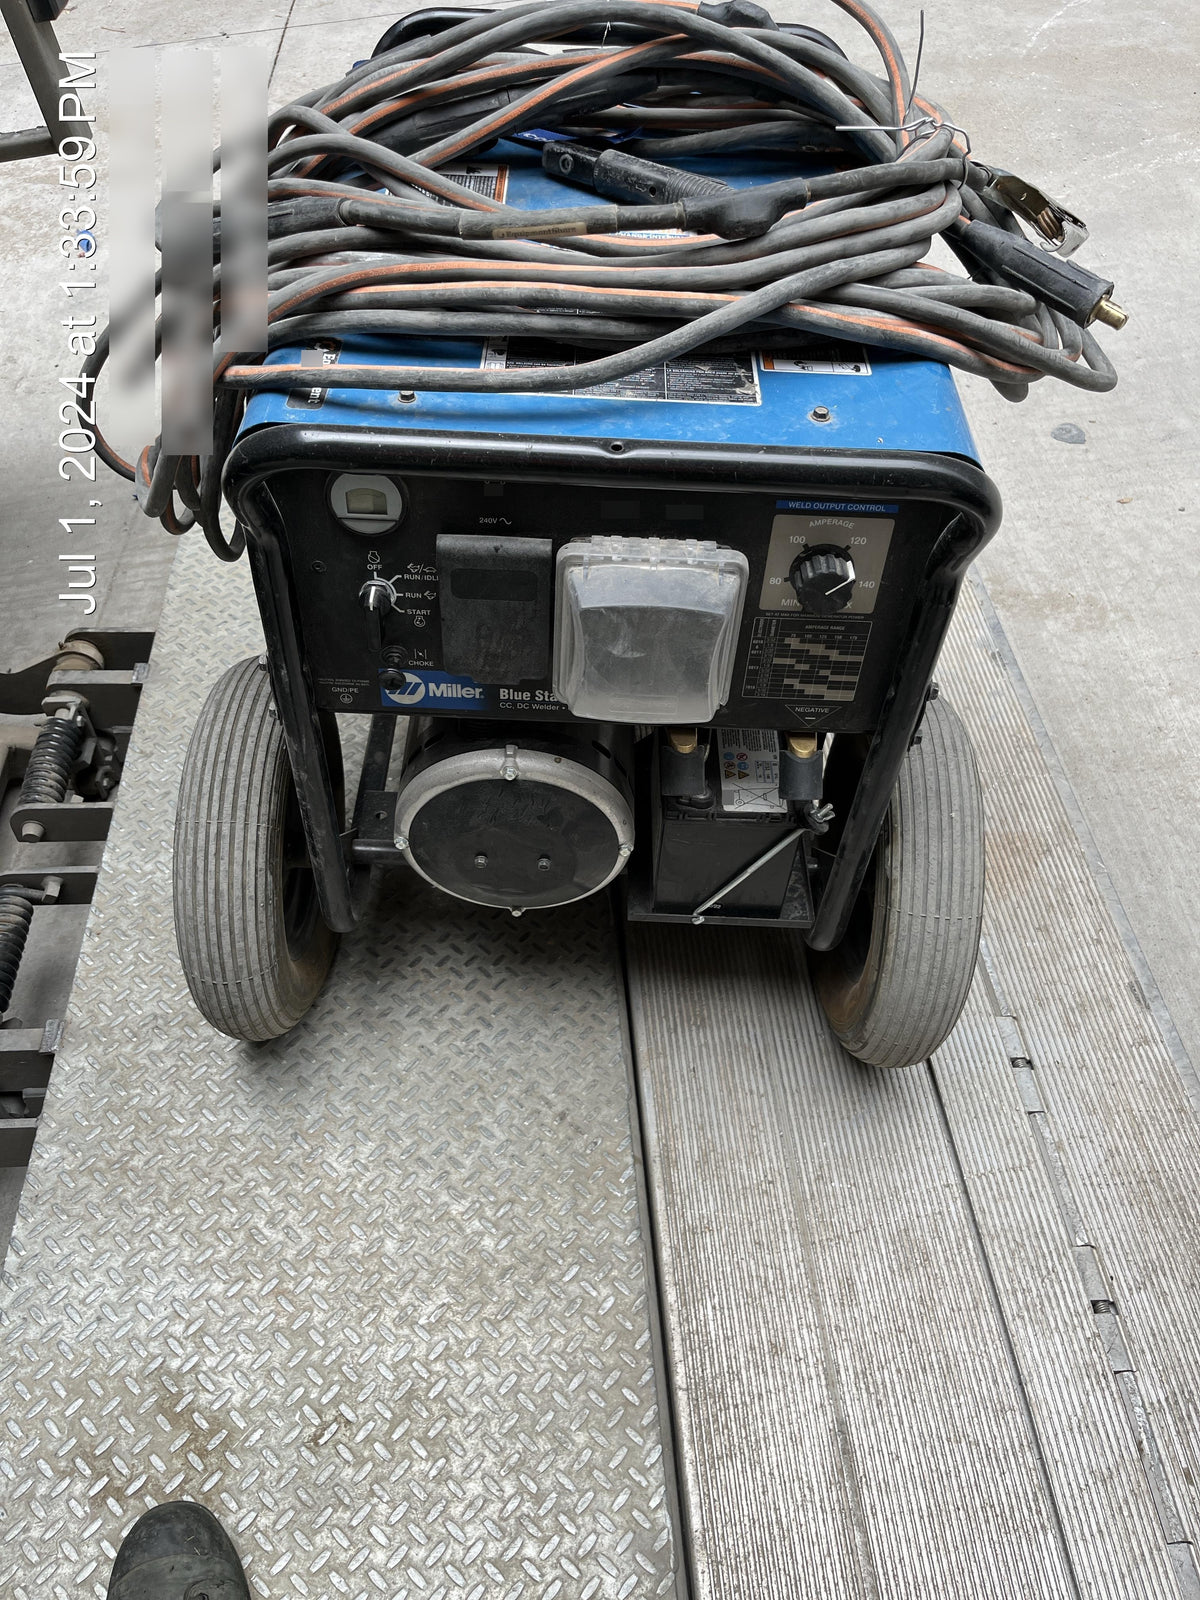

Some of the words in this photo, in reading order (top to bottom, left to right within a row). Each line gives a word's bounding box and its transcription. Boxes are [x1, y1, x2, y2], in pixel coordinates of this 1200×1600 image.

[788, 501, 811, 509] WELD
[813, 502, 846, 511] OUTPUT
[847, 504, 886, 512] CONTROL
[479, 516, 498, 524] 240V
[809, 518, 855, 529] AMPERAGE
[789, 535, 806, 544] 100
[850, 536, 867, 545] 120
[769, 577, 782, 585] 80
[858, 580, 875, 589] 140
[406, 608, 431, 616] START
[331, 686, 359, 694] GND/PE
[428, 682, 483, 699] Miller
[499, 688, 531, 701] Blue
[535, 689, 559, 702] Sta
[499, 702, 515, 710] CC,
[517, 702, 530, 710] DC
[531, 703, 560, 711] Welder
[794, 706, 830, 714] NEGATIVE
